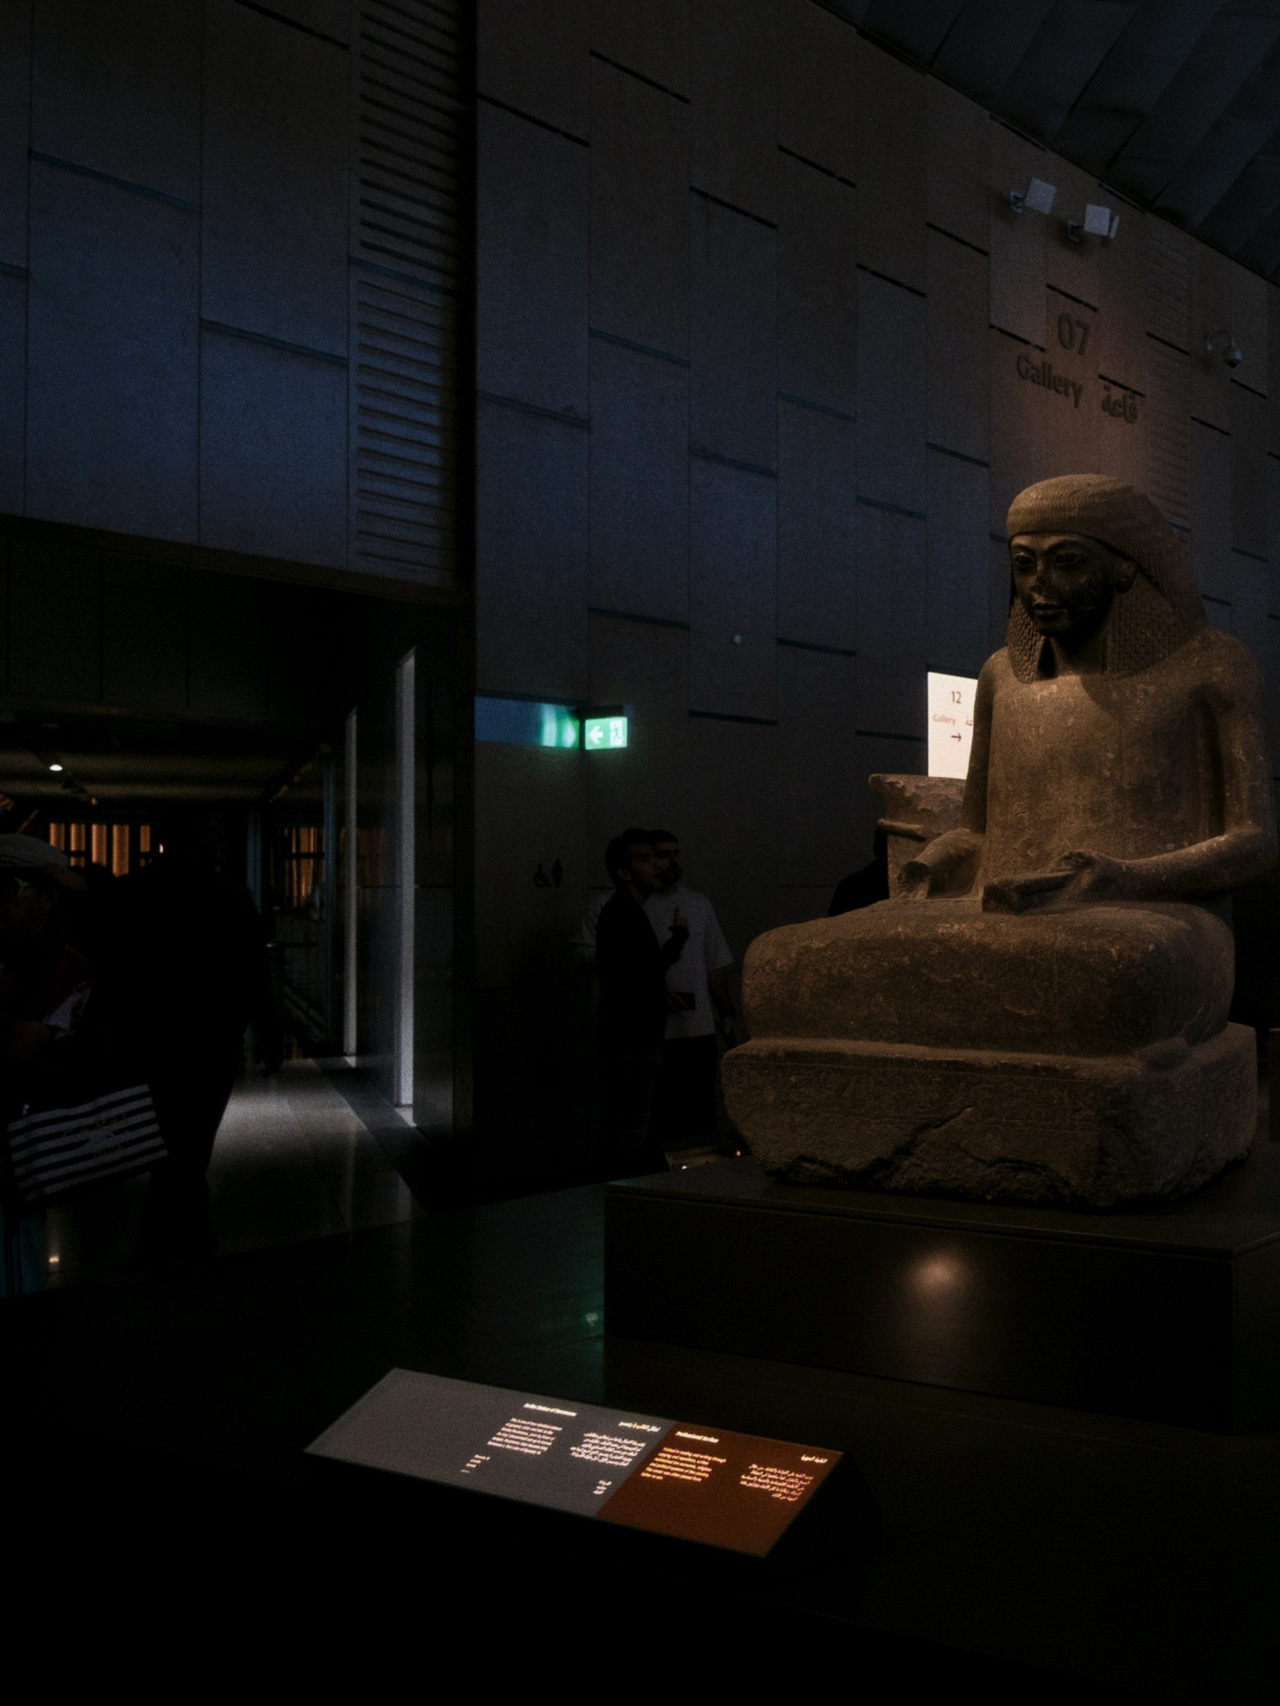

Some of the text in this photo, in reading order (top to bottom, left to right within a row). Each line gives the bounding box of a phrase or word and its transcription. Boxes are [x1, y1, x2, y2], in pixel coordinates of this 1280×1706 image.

[1057, 312, 1091, 356] 07
[1016, 354, 1084, 409] Gallery
[1101, 383, 1139, 424] قاعة
[950, 690, 962, 704] 12
[932, 713, 956, 727] Gallery
